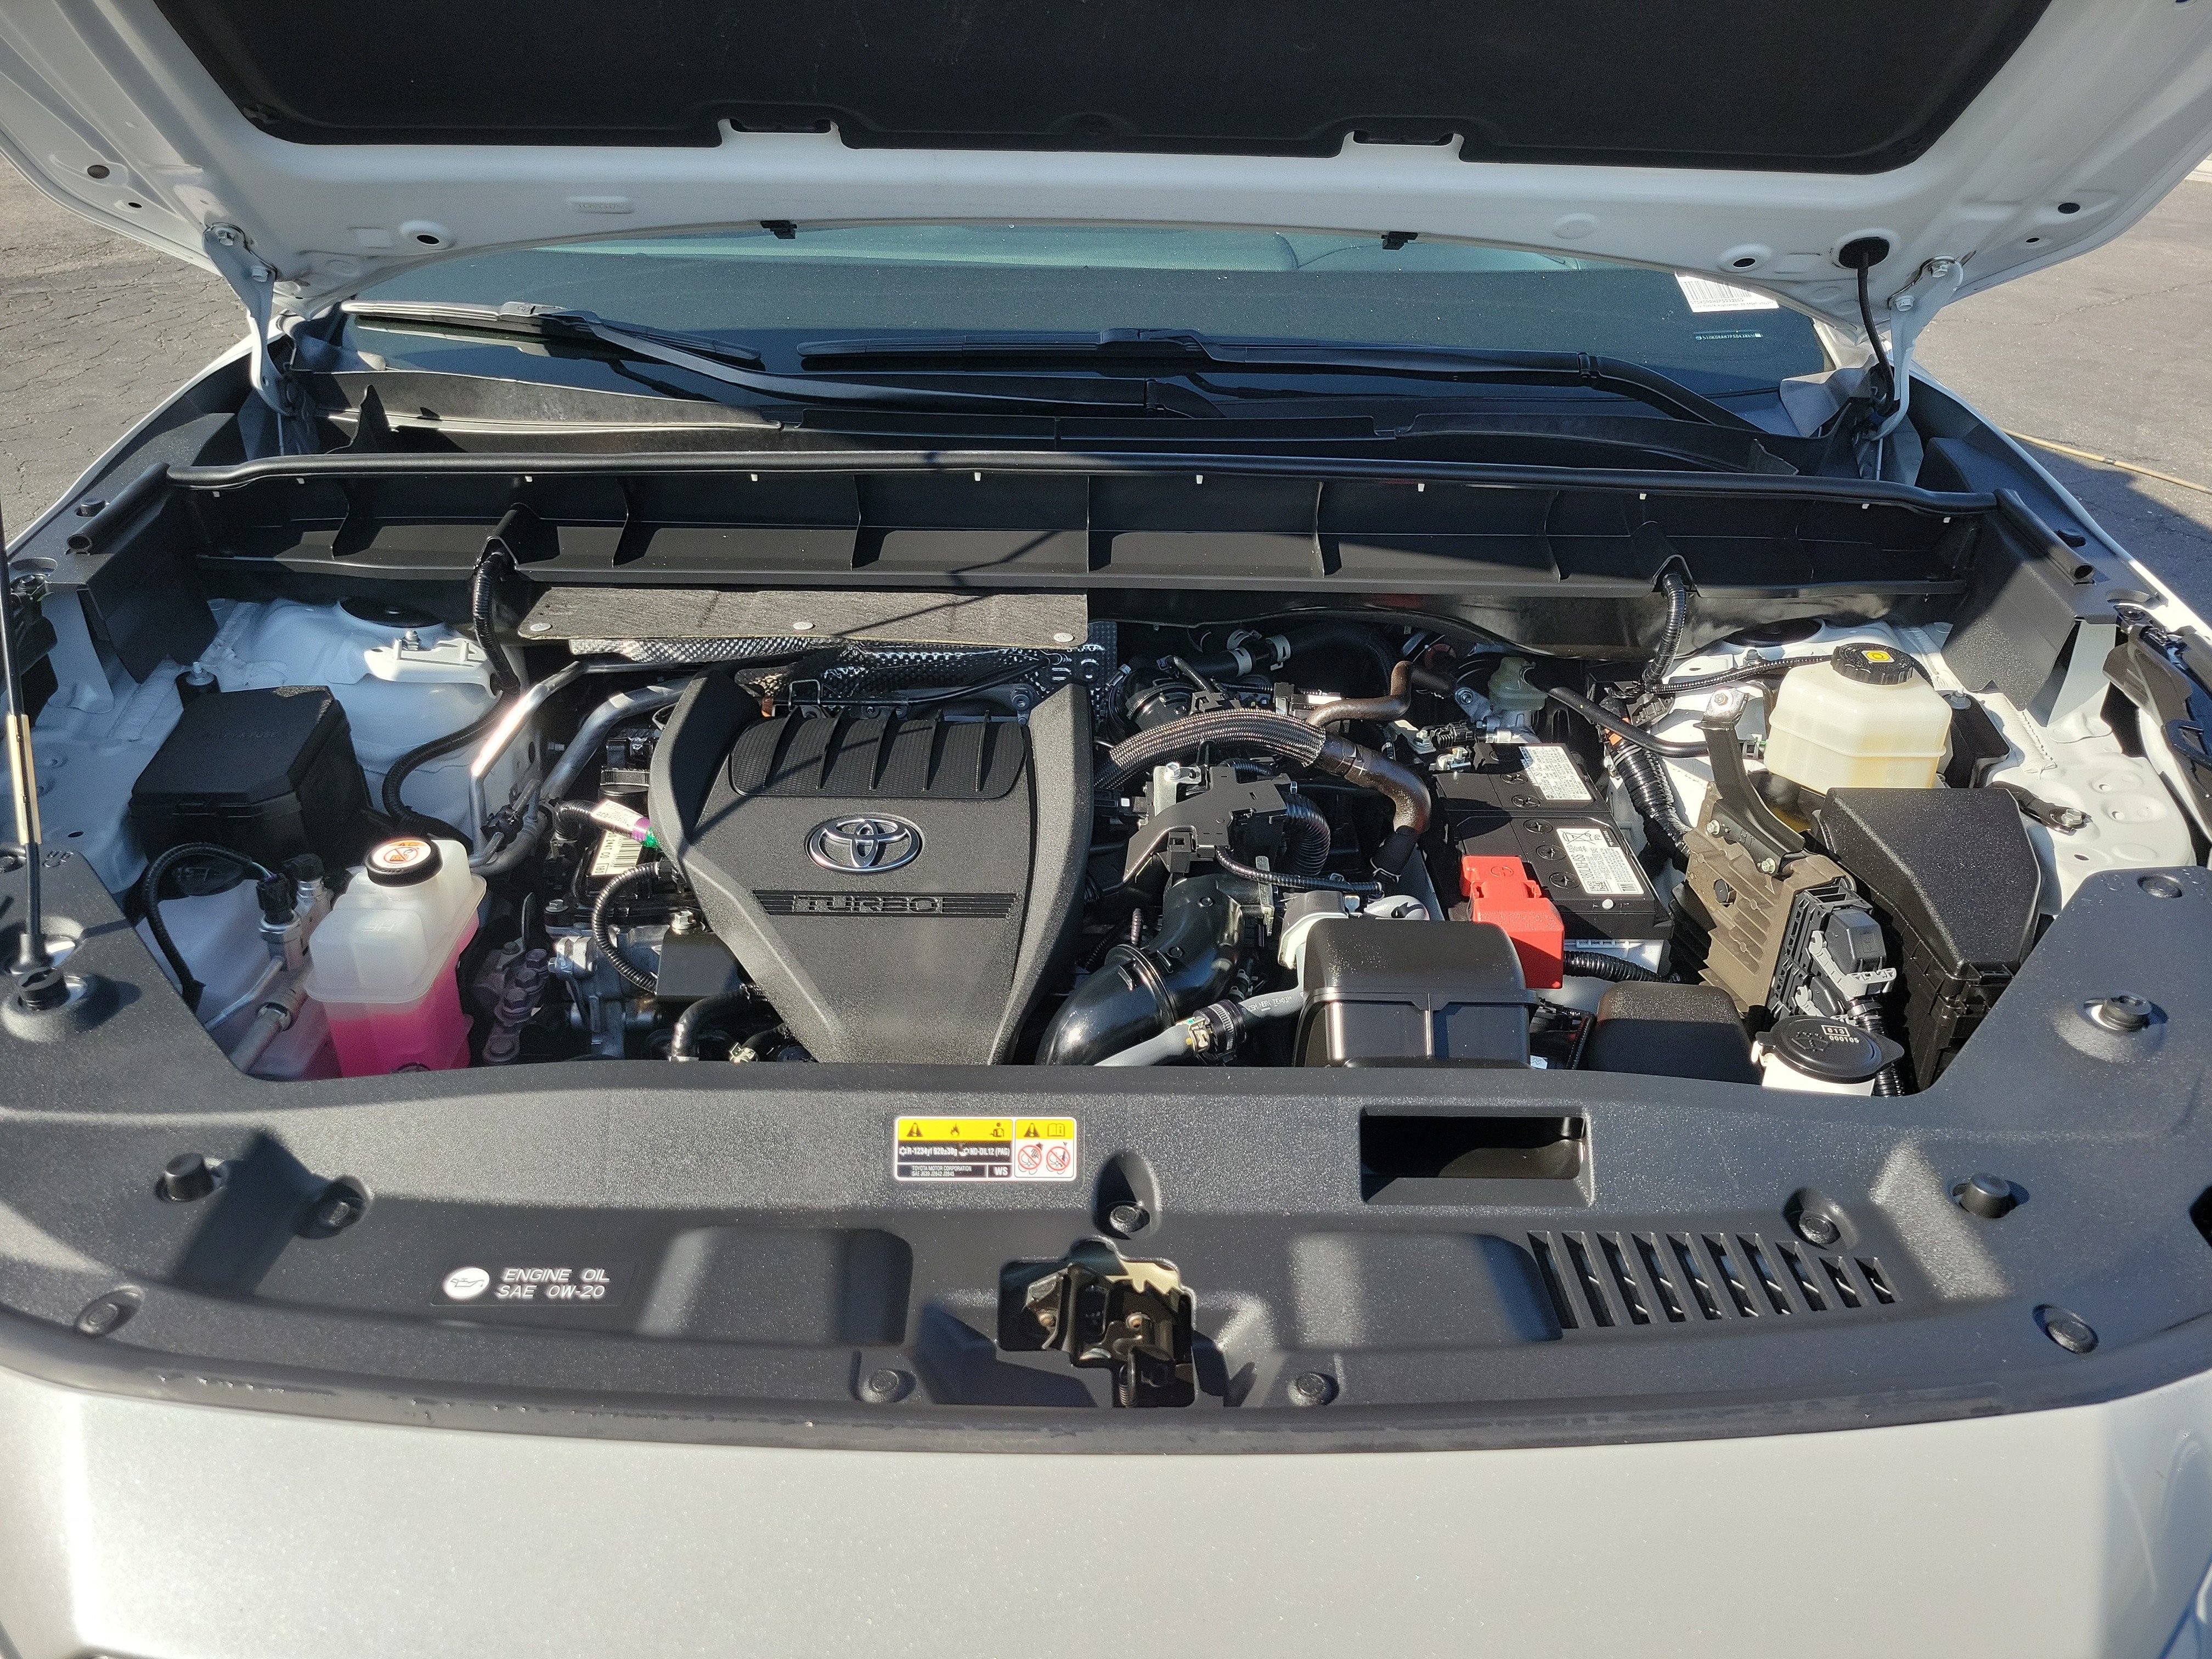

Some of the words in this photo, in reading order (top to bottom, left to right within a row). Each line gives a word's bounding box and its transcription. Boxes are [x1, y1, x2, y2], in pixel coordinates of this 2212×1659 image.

[798, 896, 938, 912] TURBO
[1829, 1035, 1859, 1043] 000105
[907, 1147, 932, 1156] R-1234yf
[995, 1148, 1010, 1156] (PAG)
[994, 1166, 1008, 1175] WS
[503, 1268, 572, 1282] ENGINE
[582, 1268, 611, 1282] OIL
[496, 1285, 537, 1299] SAE
[548, 1285, 605, 1299] 0W-20
